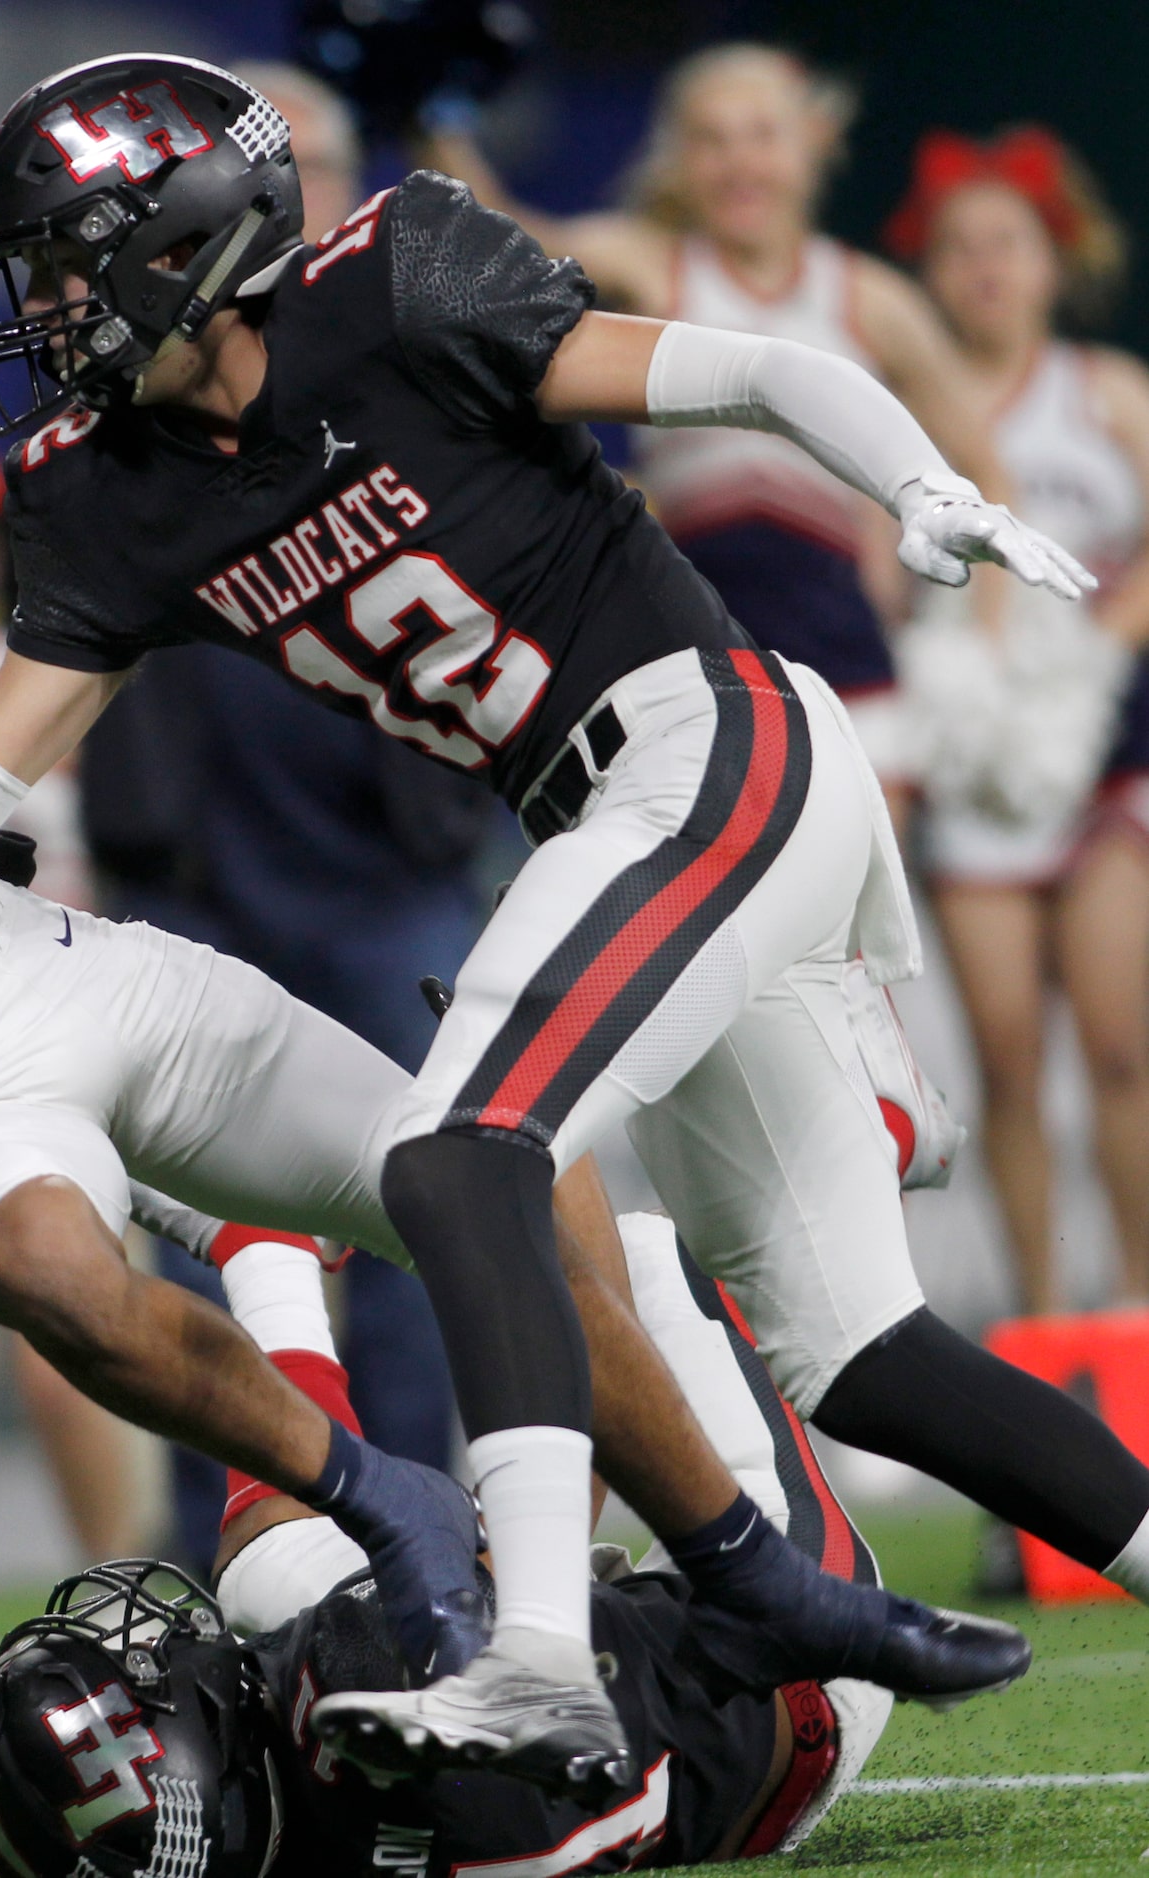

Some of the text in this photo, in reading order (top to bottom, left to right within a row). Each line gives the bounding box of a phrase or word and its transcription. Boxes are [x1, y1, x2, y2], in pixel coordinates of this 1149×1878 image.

[32, 79, 215, 185] LH
[194, 462, 430, 637] WILDCATS
[278, 548, 553, 769] 12
